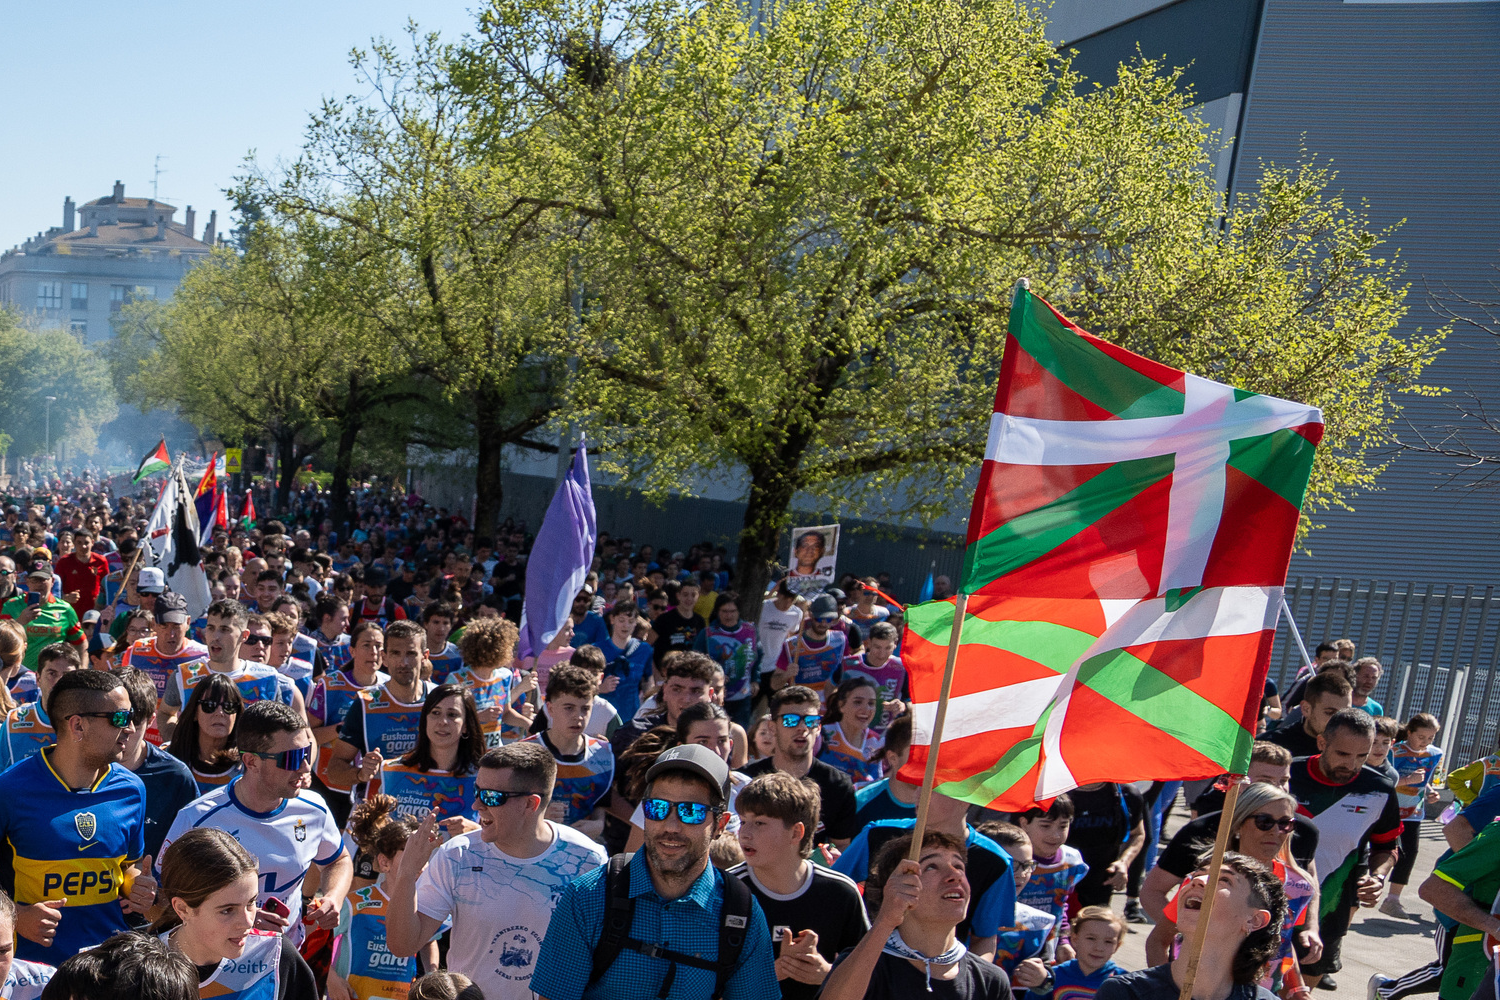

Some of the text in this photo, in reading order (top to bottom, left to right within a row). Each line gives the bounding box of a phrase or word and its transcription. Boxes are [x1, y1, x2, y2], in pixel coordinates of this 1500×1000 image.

[381, 733, 416, 742] Euskara
[386, 740, 417, 752] gara
[238, 960, 267, 974] eitb
[18, 973, 51, 987] eitb
